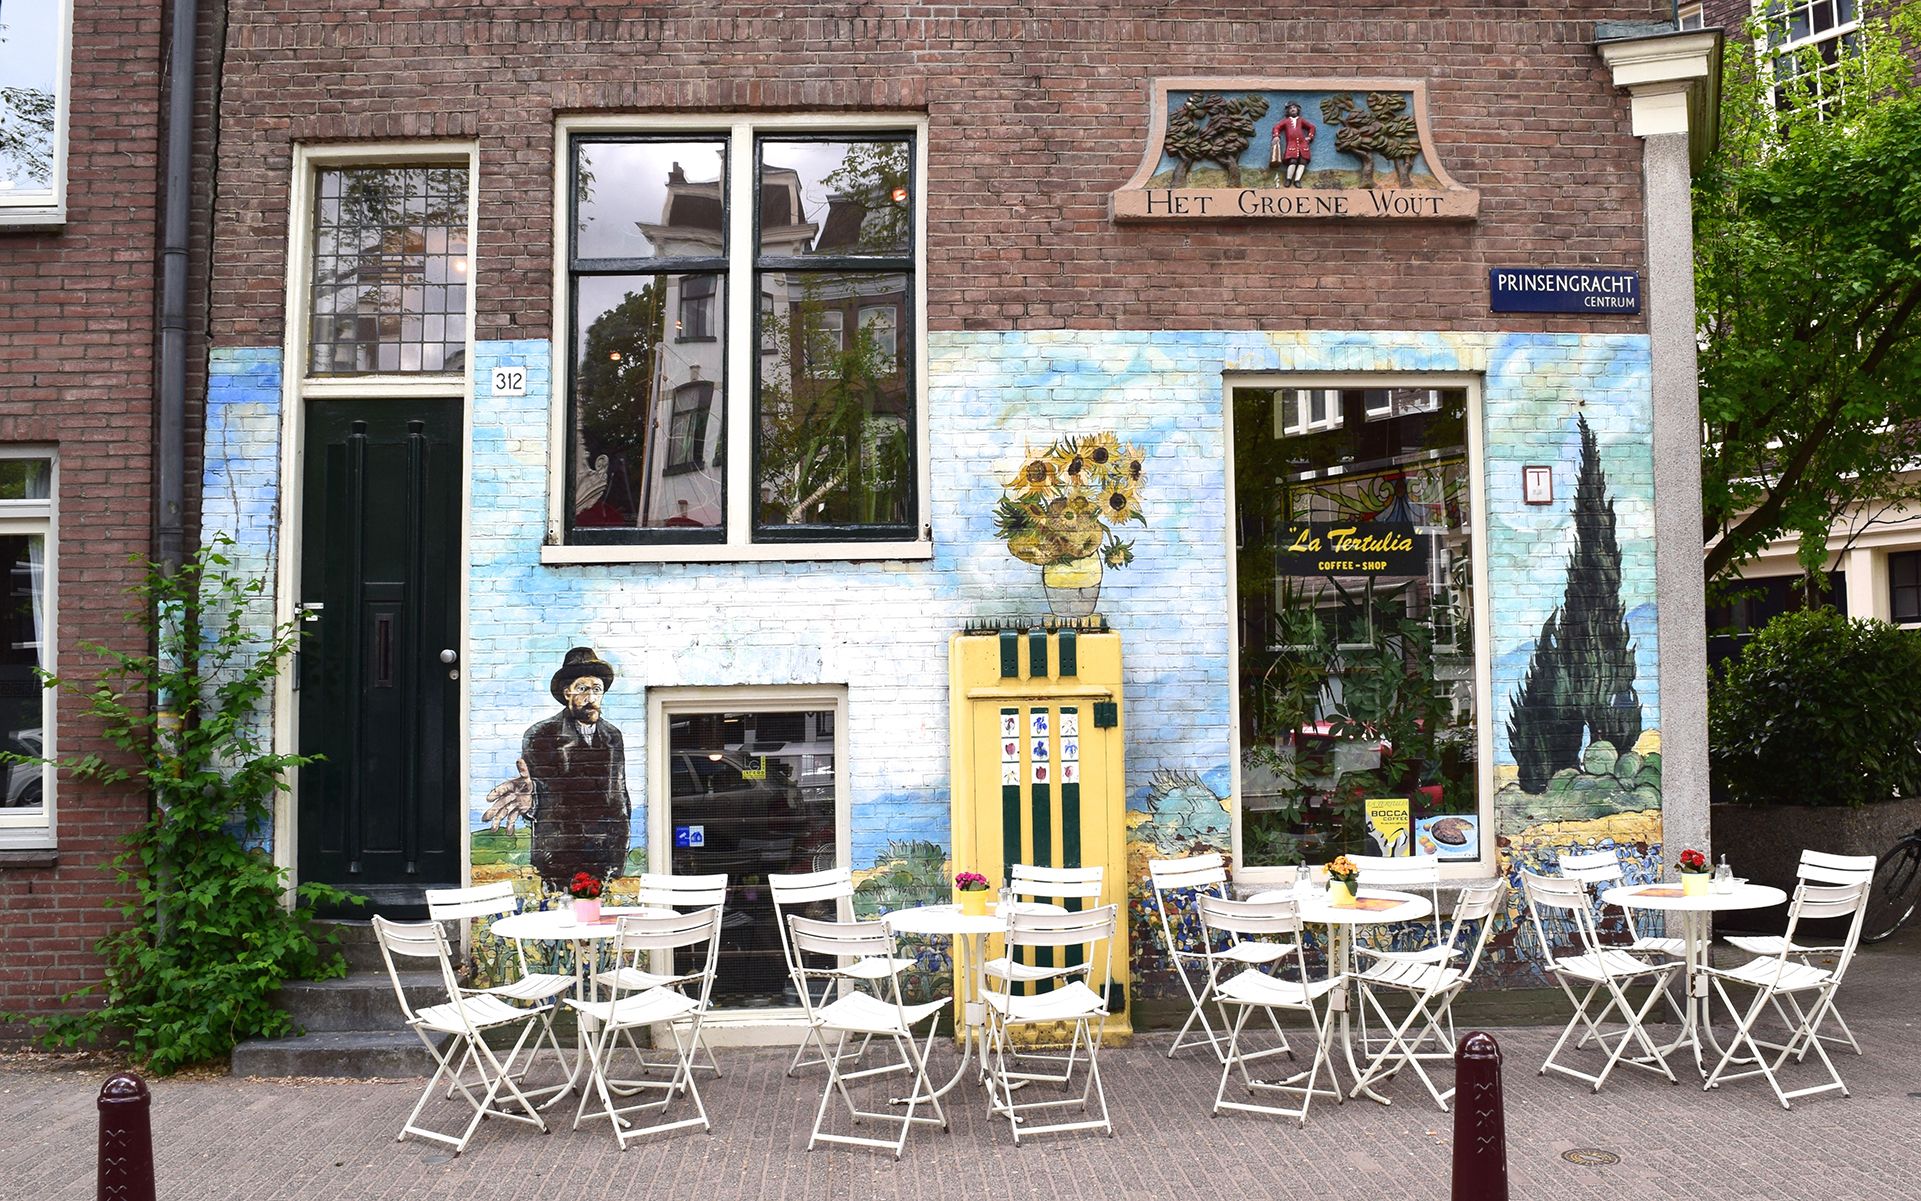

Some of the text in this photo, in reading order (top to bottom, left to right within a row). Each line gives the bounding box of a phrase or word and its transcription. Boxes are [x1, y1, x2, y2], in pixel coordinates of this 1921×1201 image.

[1146, 189, 1213, 214] HET
[1237, 189, 1349, 215] GROENE
[1497, 274, 1634, 293] PRINSENGRACHT
[1583, 296, 1635, 308] CENTRUM
[496, 373, 522, 390] 312
